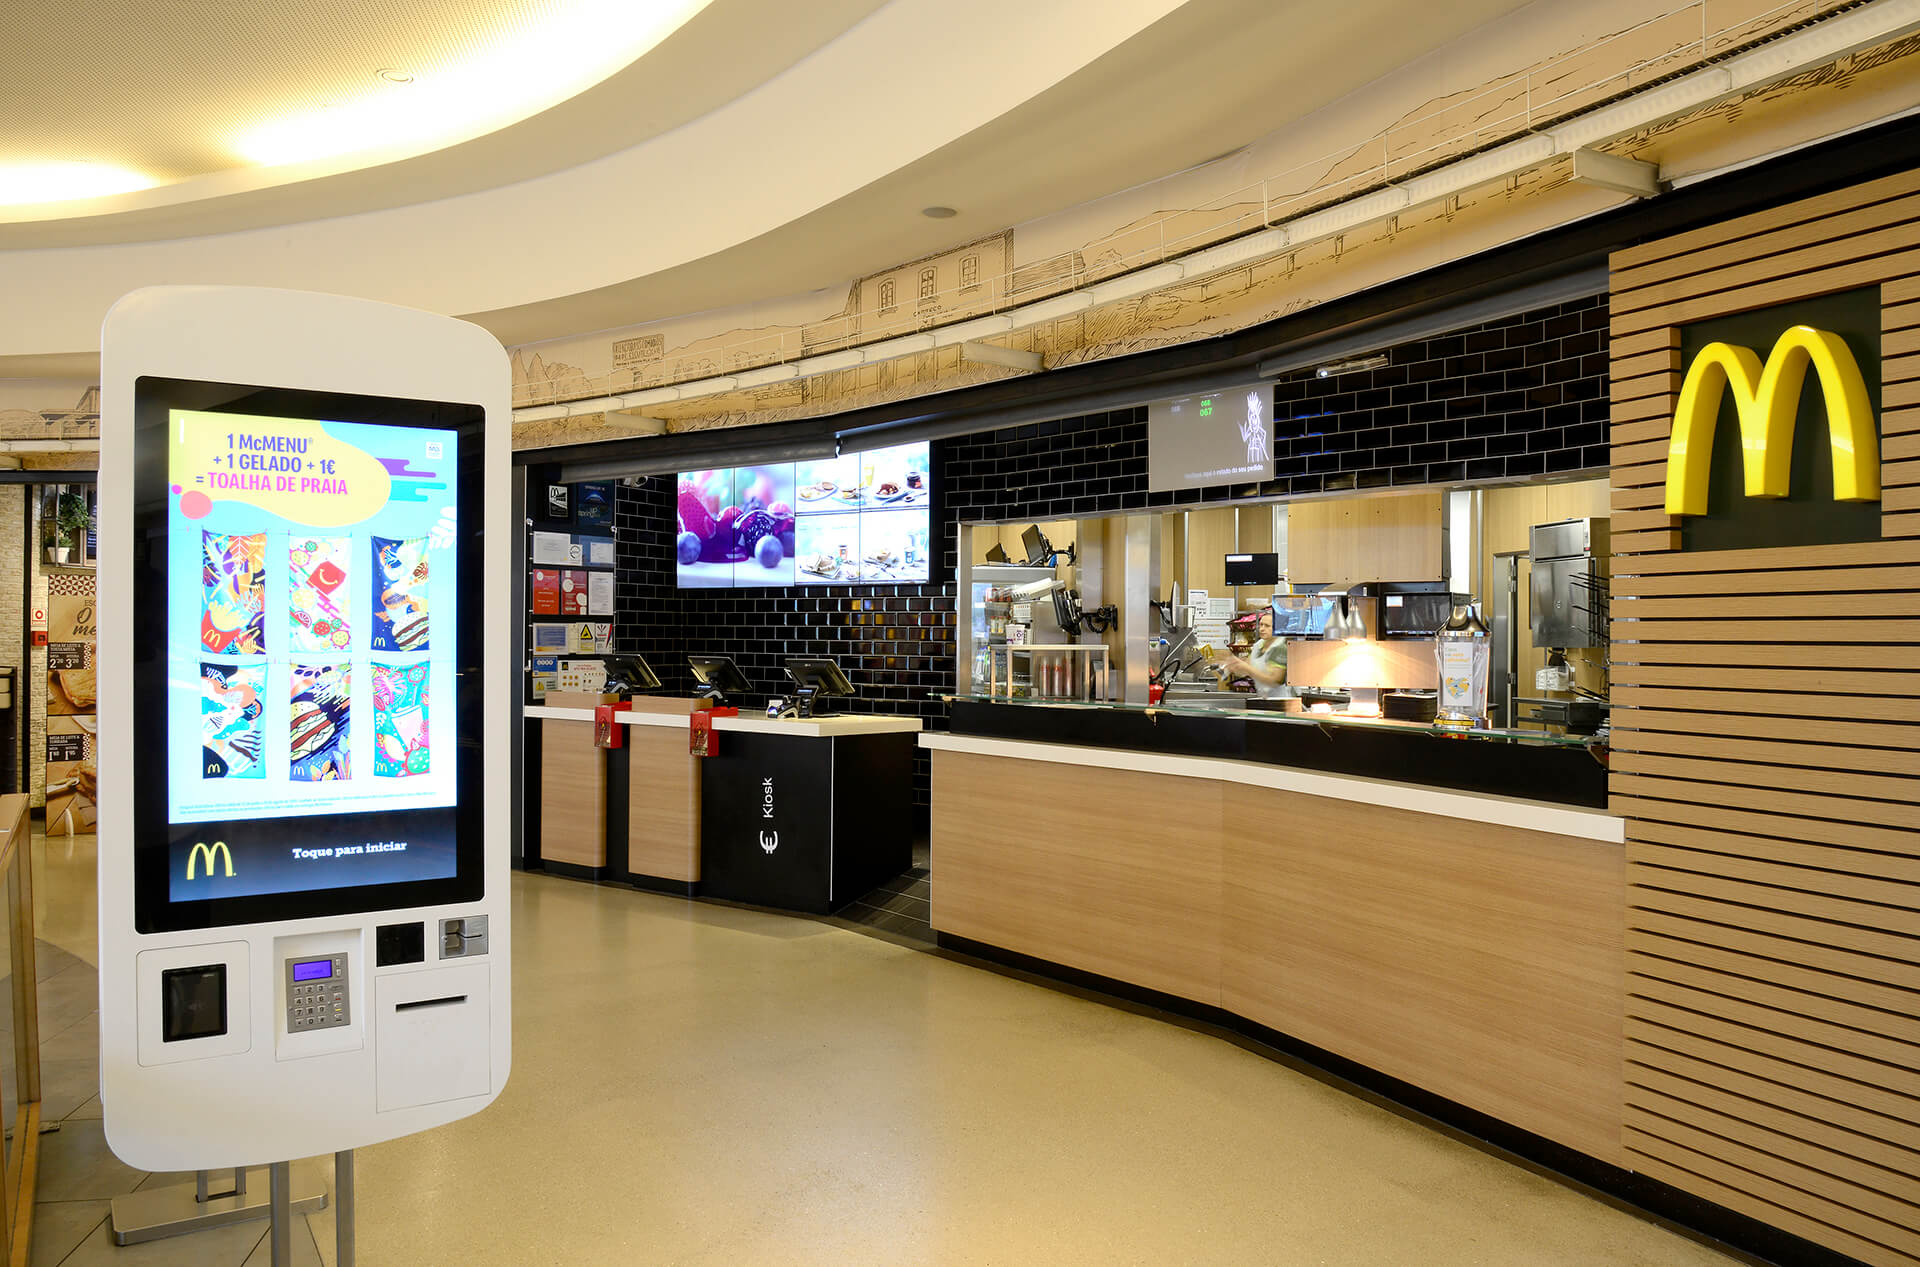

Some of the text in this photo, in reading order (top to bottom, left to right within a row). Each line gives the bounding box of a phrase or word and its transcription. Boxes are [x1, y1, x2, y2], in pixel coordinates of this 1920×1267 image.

[227, 433, 233, 448] 1
[227, 453, 233, 468] 1
[239, 453, 302, 472] GELADO
[320, 459, 336, 475] 1€
[207, 472, 271, 491] TOALHA
[276, 475, 296, 492] DE
[301, 477, 348, 495] PRAIA
[77, 607, 92, 624] O
[762, 777, 774, 818] Kiosk
[292, 841, 407, 859] Toque para iniciar
